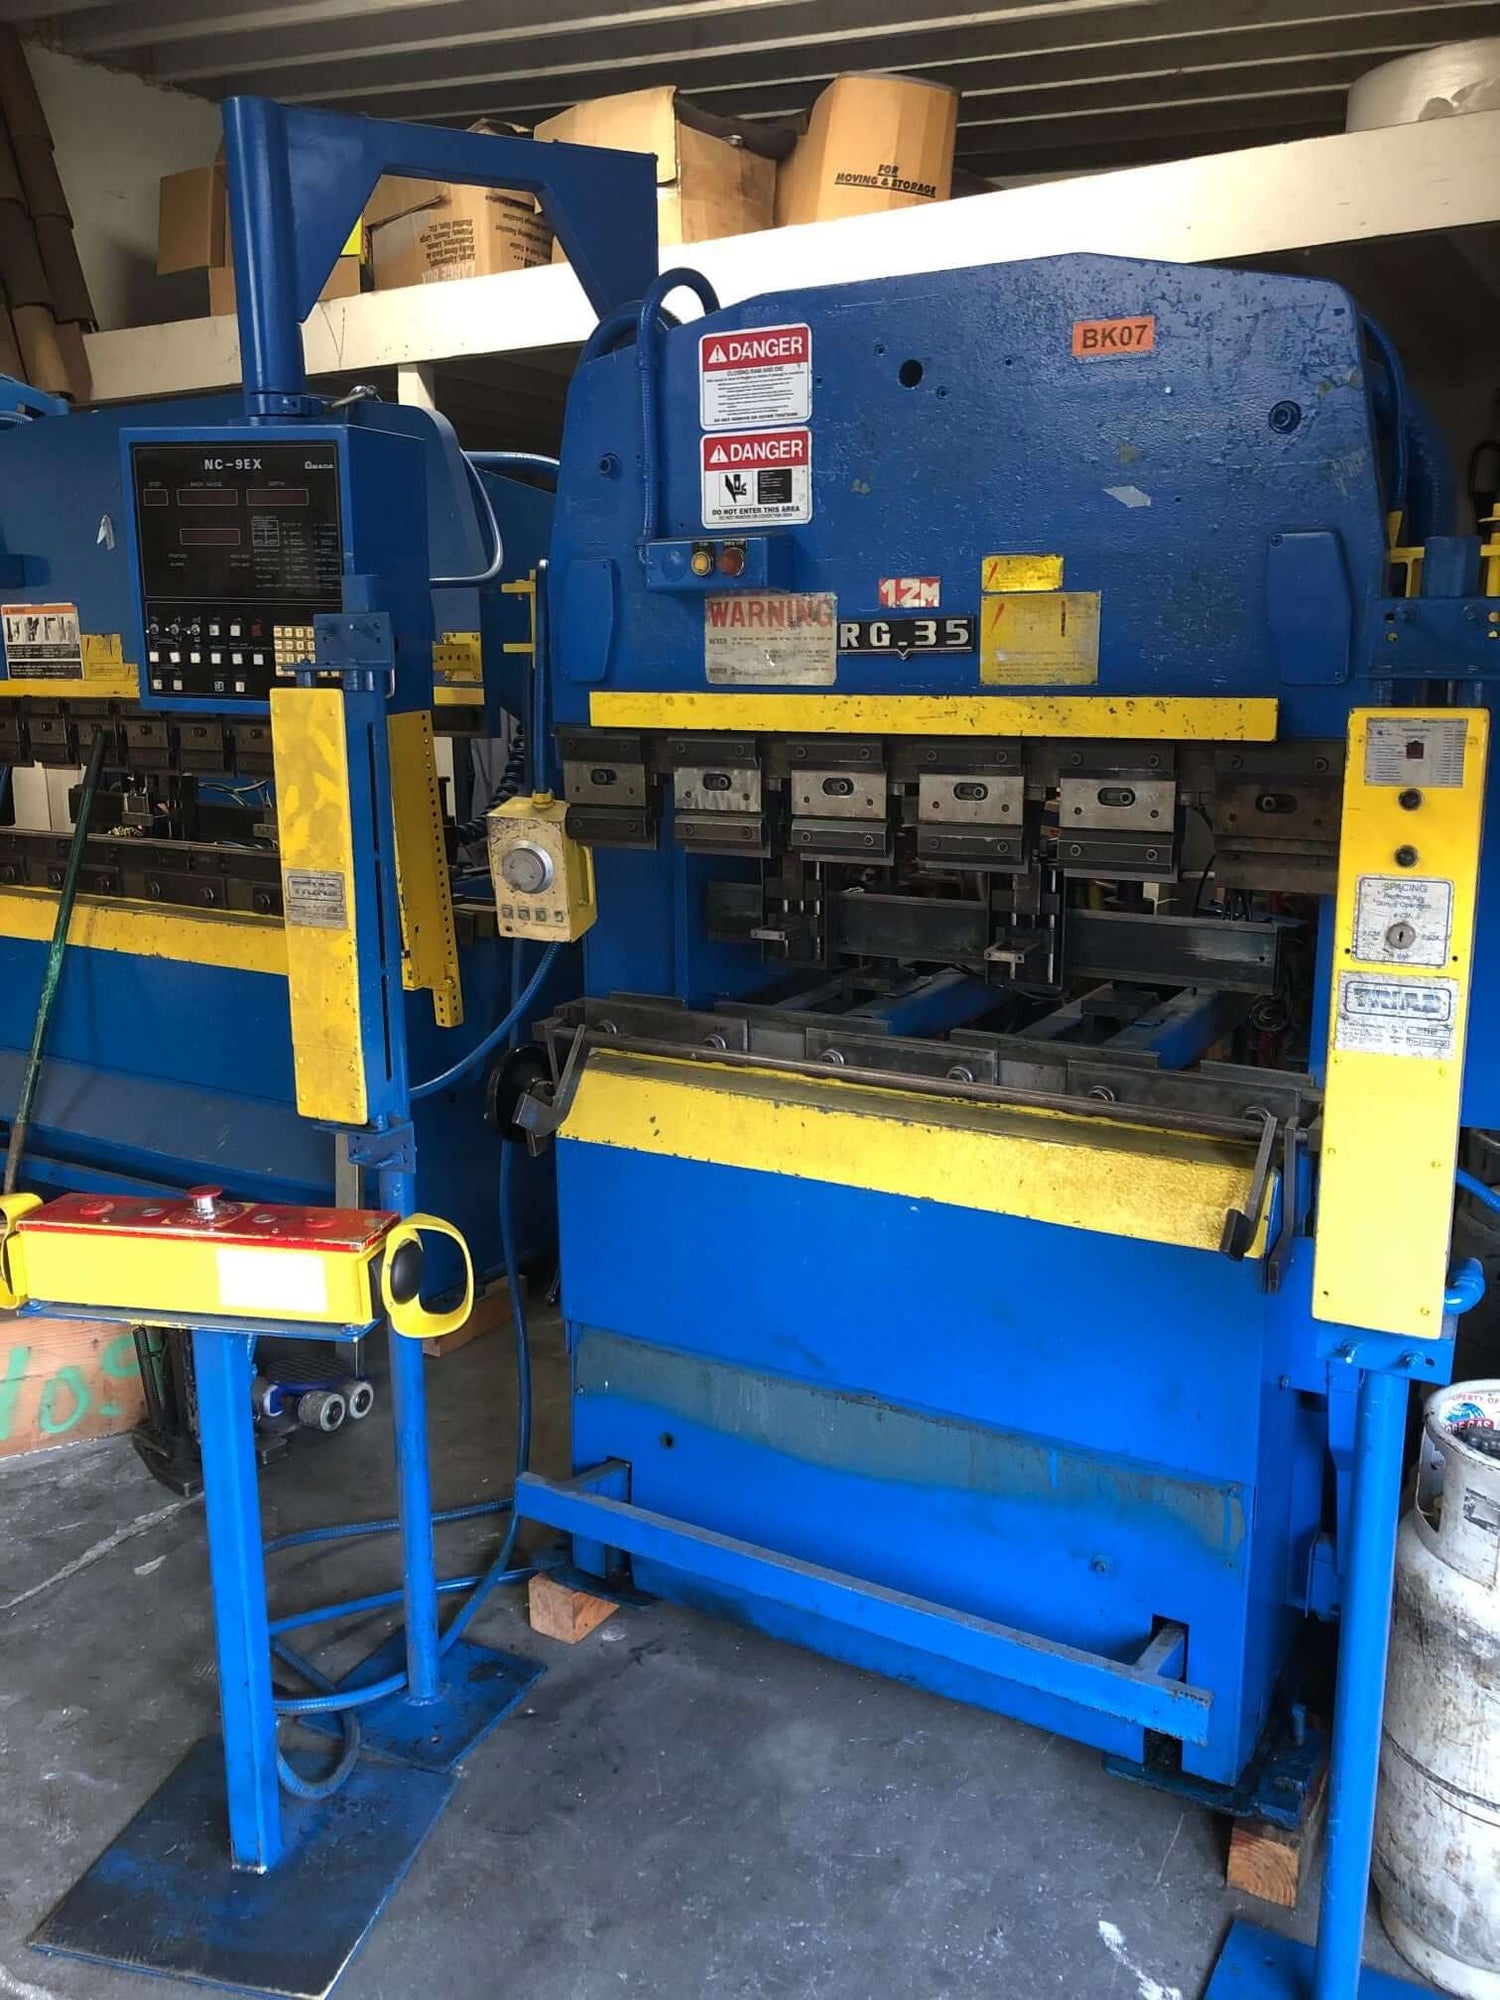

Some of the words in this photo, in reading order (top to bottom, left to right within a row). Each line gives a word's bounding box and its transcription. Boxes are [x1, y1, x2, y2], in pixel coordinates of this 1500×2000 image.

[878, 164, 899, 174] FOR
[836, 172, 878, 185] MOVING
[880, 178, 889, 186] &
[891, 179, 937, 195] STORAGE
[1082, 325, 1148, 348] BK07
[729, 336, 803, 361] DANGER
[730, 440, 803, 462] DANGER
[204, 459, 262, 470] NC-9EX
[781, 505, 800, 513] AREA
[707, 598, 833, 628] WARNING
[1383, 883, 1428, 893] SPACING
